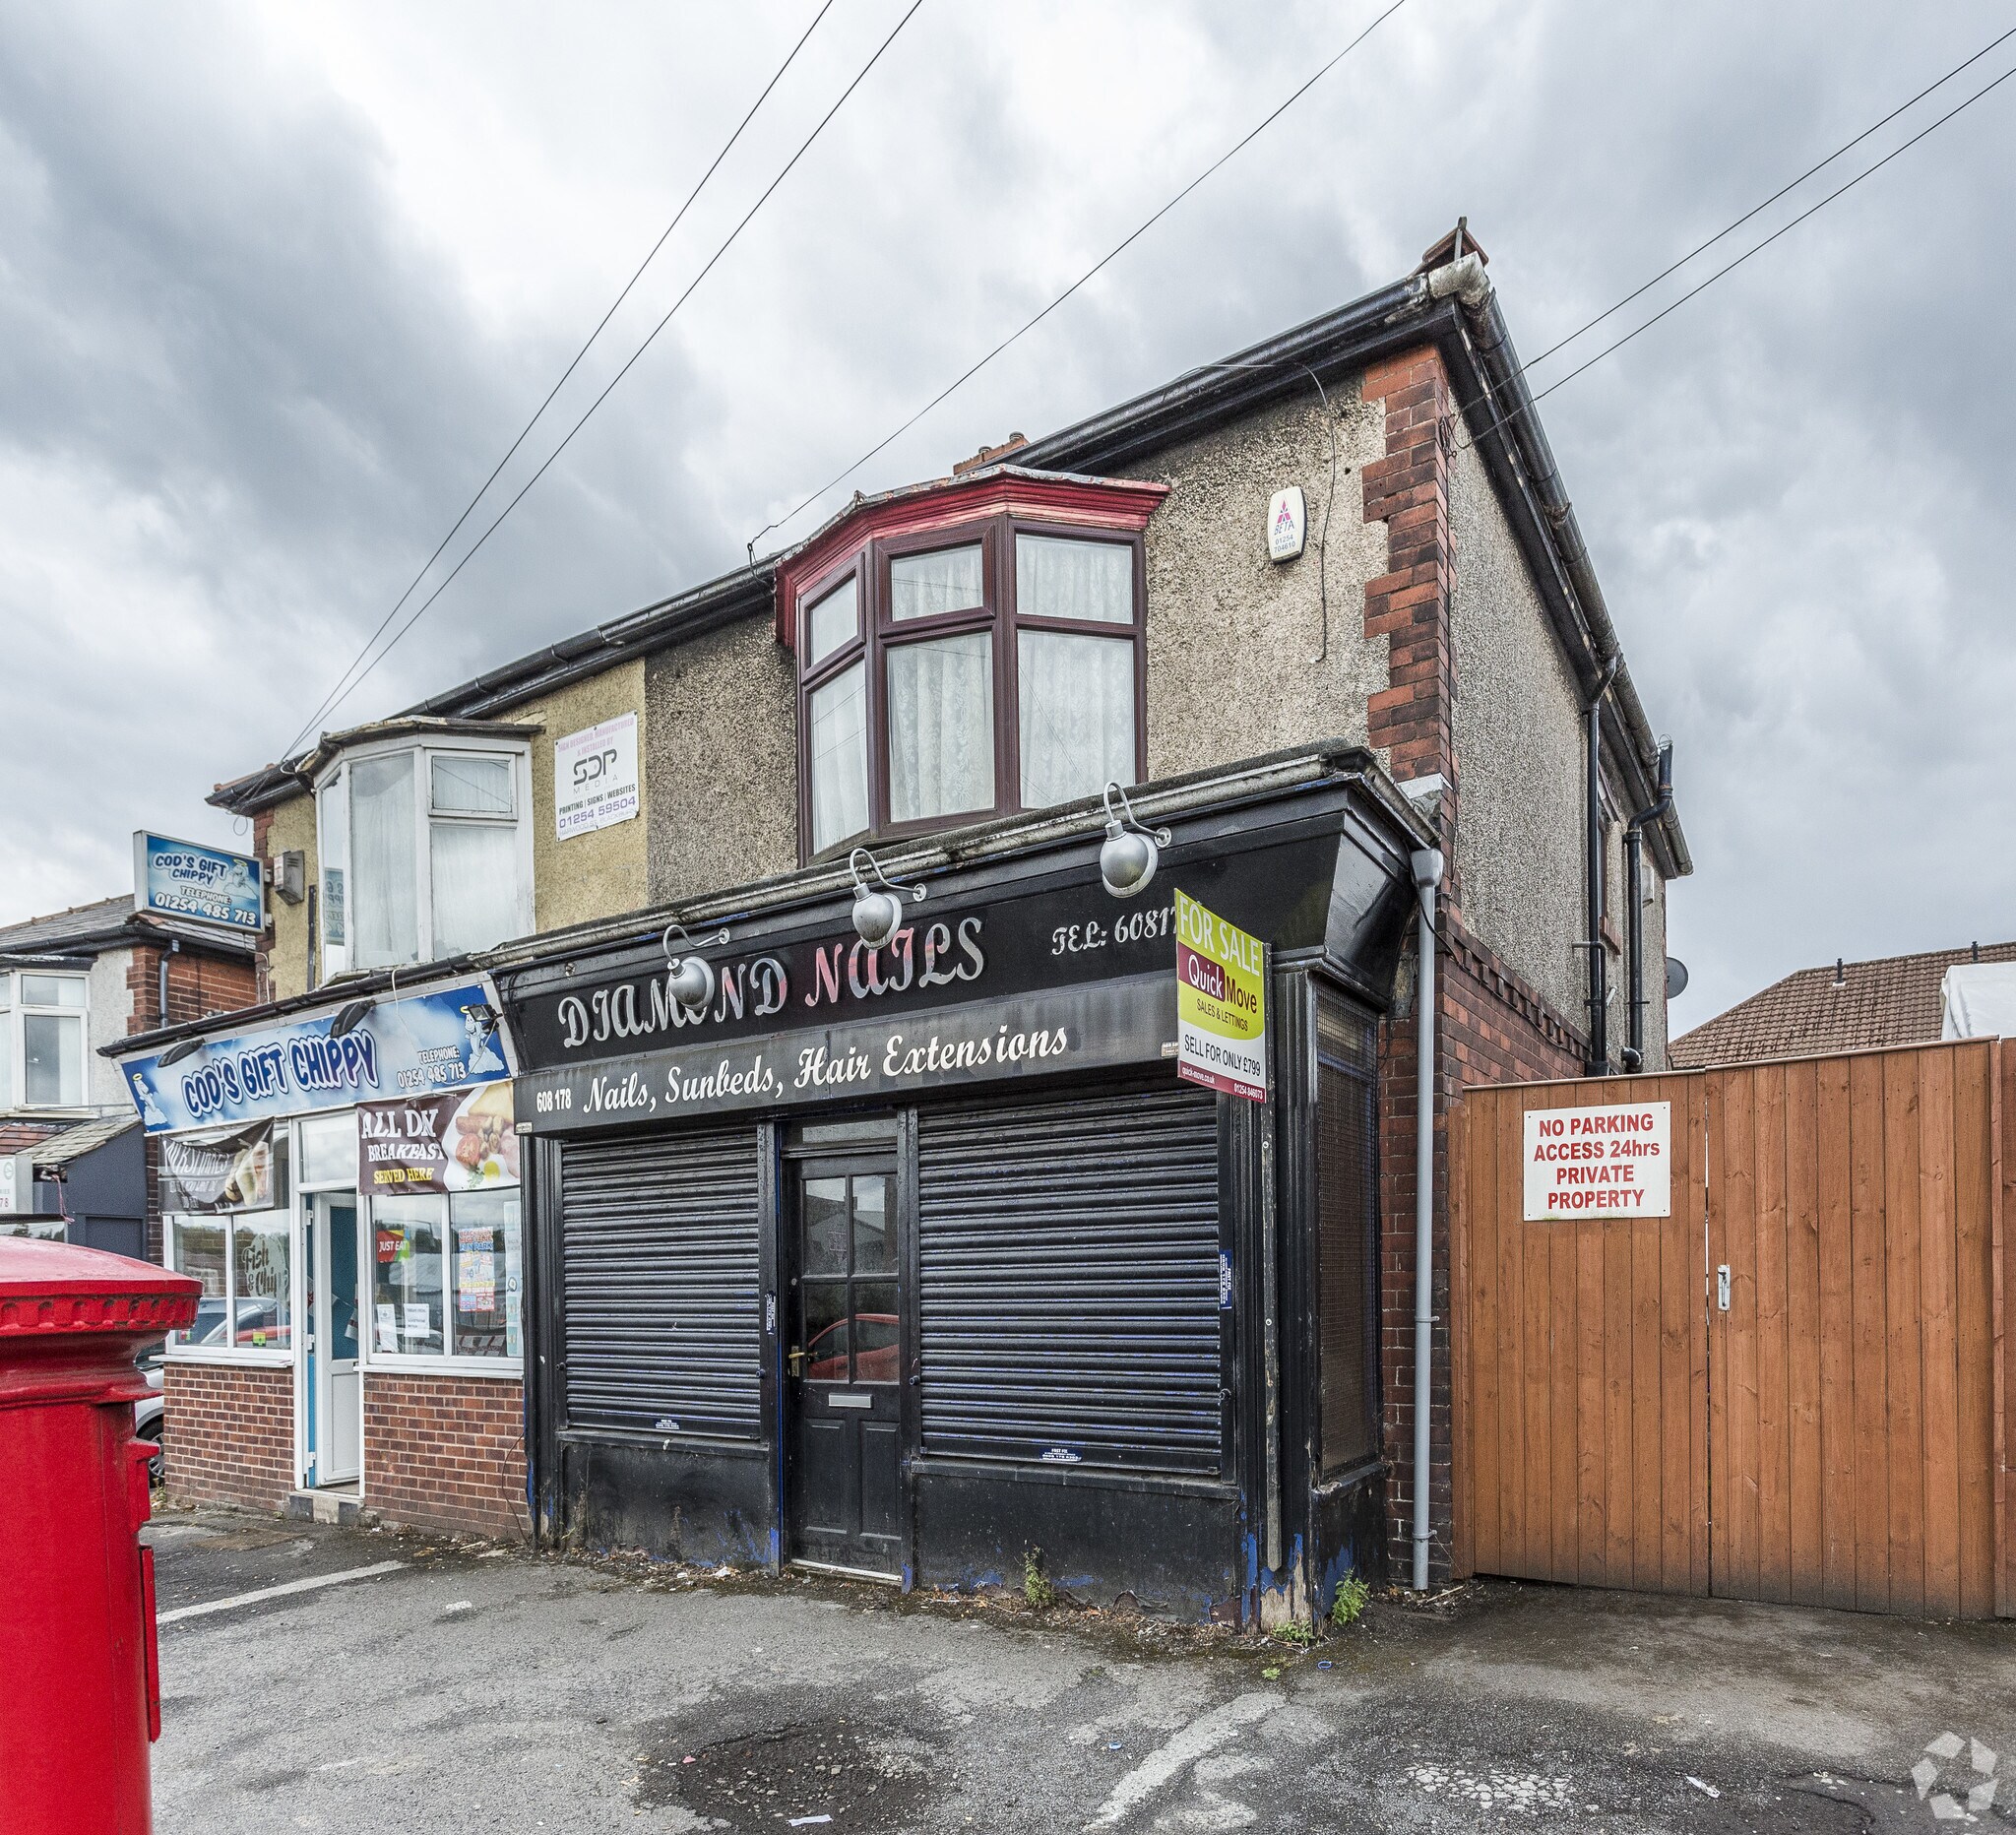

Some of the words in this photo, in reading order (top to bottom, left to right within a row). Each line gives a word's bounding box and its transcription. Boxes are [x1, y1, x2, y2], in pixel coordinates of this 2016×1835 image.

[574, 748, 617, 786] SDP
[574, 774, 618, 794] MEDIA
[559, 801, 584, 815] PRINTING
[587, 793, 603, 806] SIGNS
[607, 784, 636, 799] WEBSITES
[559, 809, 595, 829] 01254
[598, 796, 636, 816] 59504
[155, 854, 195, 868] COD'S
[199, 858, 227, 877] GIFT
[172, 868, 214, 885] CHIPPY
[155, 892, 198, 914] 01254
[202, 903, 231, 920] 485
[234, 909, 257, 925] 713
[180, 886, 232, 905] TELEPHONE:
[1051, 920, 1107, 956] TEL:
[1179, 895, 1216, 953] FOR
[1219, 921, 1260, 977] SALE
[558, 957, 788, 1048] DIAMND
[804, 917, 984, 1007] NAILS
[1188, 954, 1223, 999] Quick
[1226, 976, 1257, 1014] Move
[1196, 998, 1216, 1018] SALES
[1221, 1009, 1248, 1032] LETTINGS
[417, 1044, 461, 1065] TELEPHONE:
[536, 1091, 553, 1112] 608
[555, 1088, 572, 1110] 178
[583, 1071, 657, 1112] Nails,
[664, 1054, 784, 1099] Sunbeds,
[793, 1045, 871, 1089] Hair
[882, 1025, 1067, 1077] Extensions
[1184, 1034, 1204, 1057] SELL
[1206, 1043, 1222, 1064] FOR
[1223, 1049, 1241, 1071] ONLY
[1243, 1057, 1261, 1077] £799
[183, 1059, 242, 1115] COD'S
[239, 1045, 288, 1098] GIFT
[289, 1032, 379, 1089] CHIPPY
[397, 1068, 425, 1089] 01254
[427, 1064, 447, 1083] 485
[448, 1061, 468, 1081] 713
[361, 1110, 402, 1139] ALL
[1540, 1119, 1564, 1137] NO
[1570, 1113, 1654, 1135] PARKING
[367, 1143, 444, 1162] BREAKFAST
[1534, 1141, 1605, 1162] ACCESS
[1609, 1139, 1661, 1159] 24hrs
[374, 1169, 406, 1184] SERVED
[407, 1168, 434, 1181] HERE
[1556, 1165, 1634, 1185] PRIVATE
[1547, 1189, 1645, 1210] PROPERTY
[242, 1239, 269, 1273] Fish
[379, 1240, 395, 1253] JUST
[395, 1240, 407, 1250] EAT
